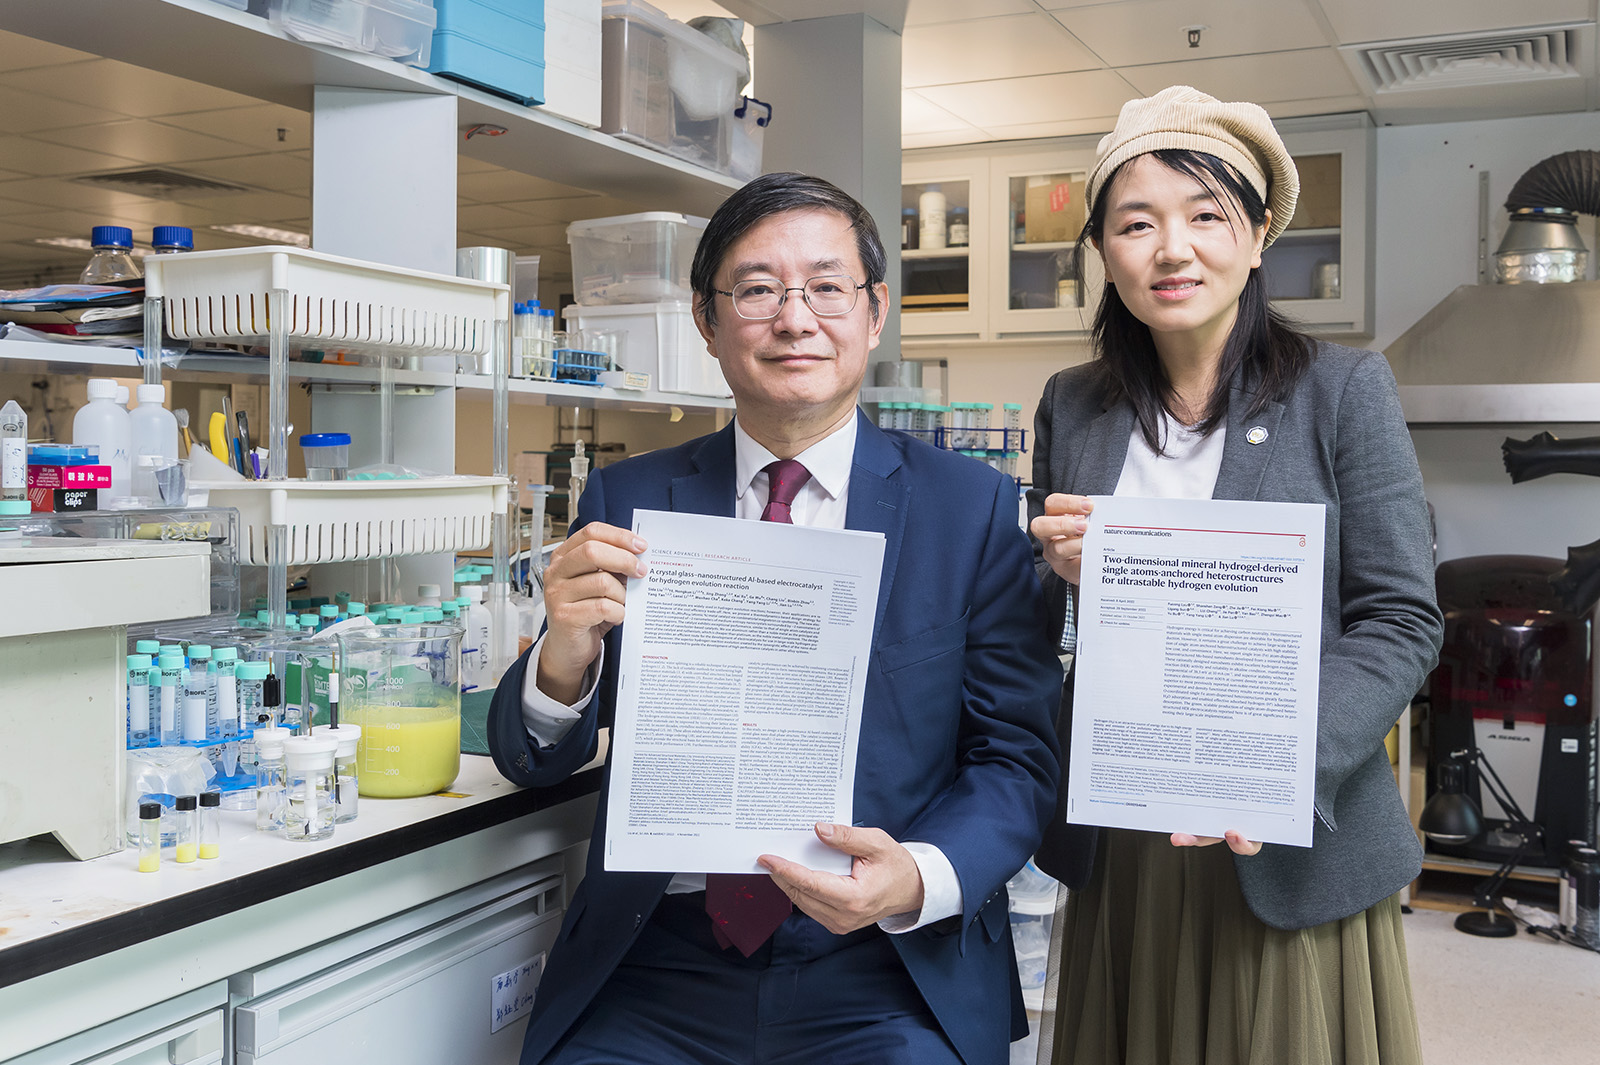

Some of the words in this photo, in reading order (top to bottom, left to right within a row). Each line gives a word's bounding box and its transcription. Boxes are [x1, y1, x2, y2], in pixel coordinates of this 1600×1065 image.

[65, 492, 88, 502] paper
[65, 498, 82, 507] clips
[1123, 528, 1172, 537] communications
[1104, 556, 1179, 567] Two-dimensional
[1181, 559, 1217, 569] mineral
[1219, 561, 1298, 576] hydrogel-derived
[656, 568, 678, 578] crystal
[678, 570, 747, 584] glass–nanostructured
[748, 576, 776, 585] Al-based
[777, 579, 823, 592] electrocatalyst
[1103, 566, 1129, 577] single
[1130, 567, 1204, 579] atoms-anchored
[1206, 571, 1284, 583] heterostructures
[659, 577, 691, 587] hydrogen
[691, 578, 722, 588] evolution
[723, 581, 750, 590] reaction
[1102, 576, 1116, 584] for
[1117, 577, 1166, 587] ultrastable
[1168, 579, 1212, 592] hydrogen
[1214, 582, 1258, 593] evolution
